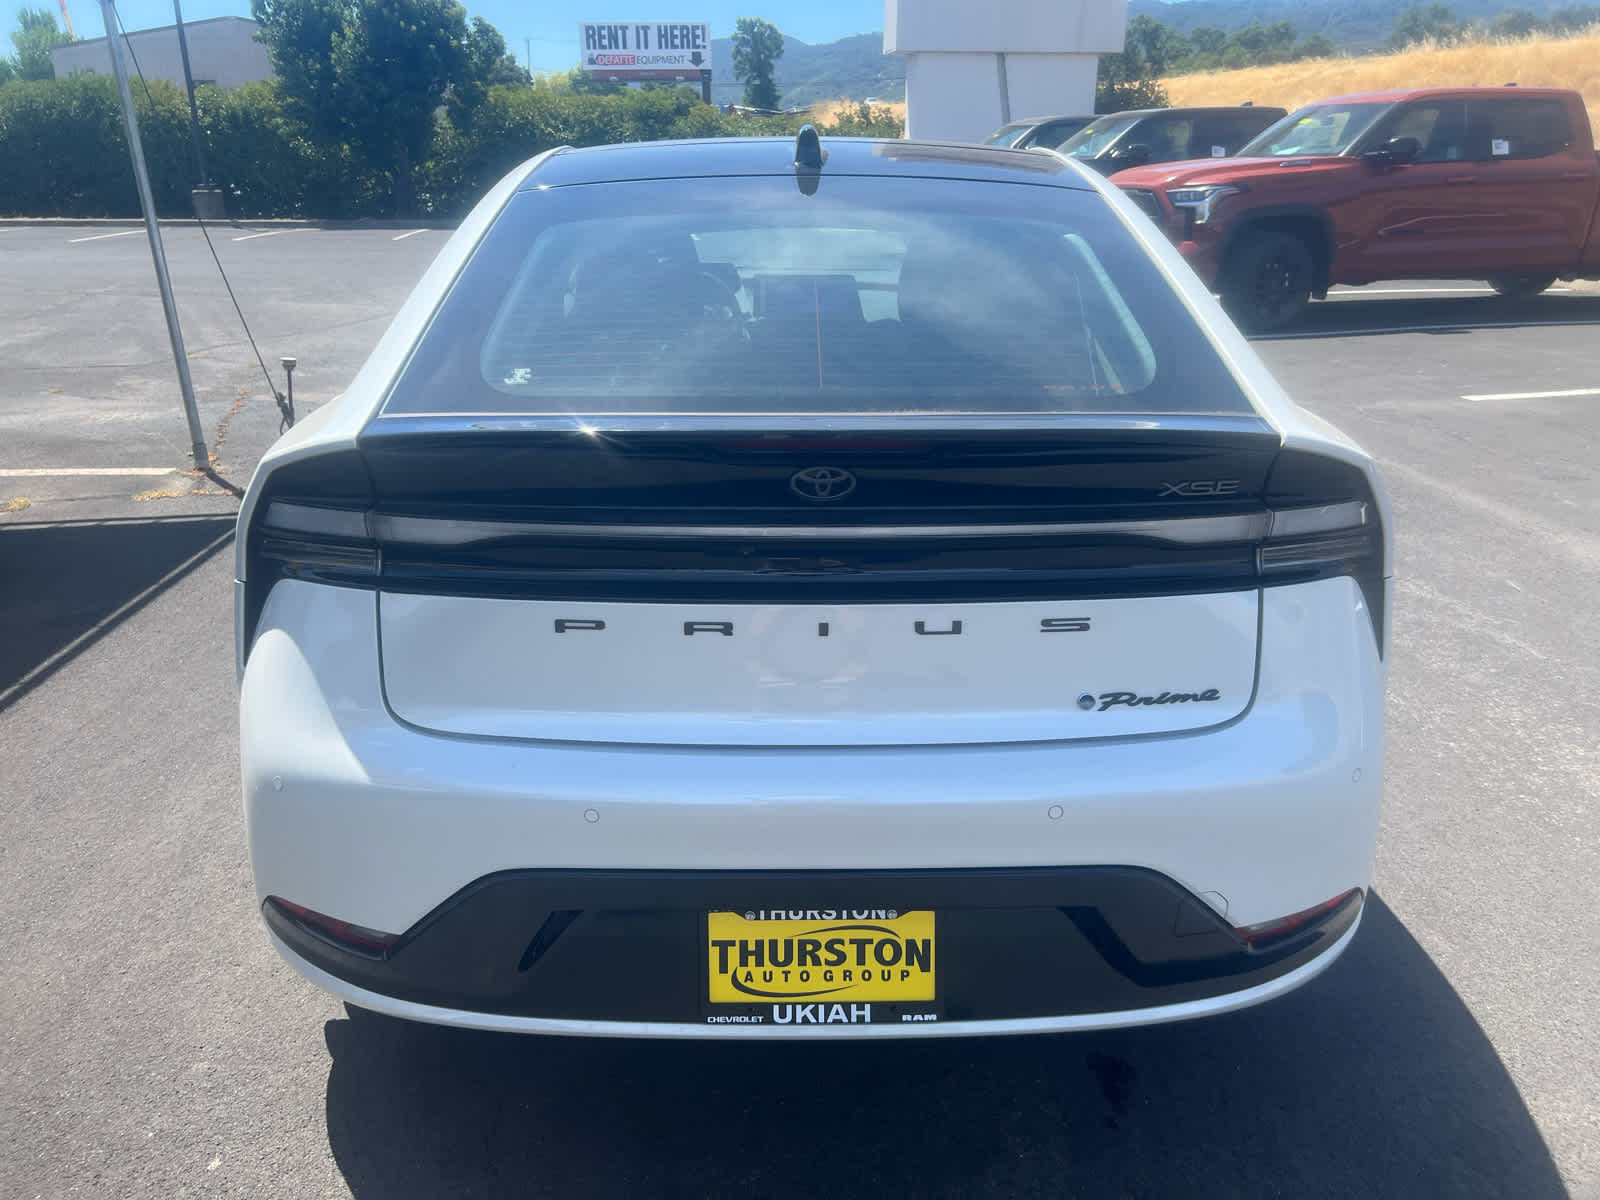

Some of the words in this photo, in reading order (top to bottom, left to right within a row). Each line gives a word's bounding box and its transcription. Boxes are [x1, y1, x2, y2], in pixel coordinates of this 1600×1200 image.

[584, 24, 629, 50] RENT
[635, 24, 650, 50] IT
[656, 24, 706, 50] HERE!
[636, 55, 685, 65] EQUIPMENT
[1157, 480, 1240, 496] XSE
[554, 617, 1091, 637] PRIUS
[1097, 688, 1221, 712] Prime
[711, 938, 931, 974] THURSTON
[744, 970, 810, 983] AUTO
[823, 969, 911, 982] GROUP
[707, 1015, 764, 1023] CHEVROLET
[772, 1003, 871, 1024] UKIAH
